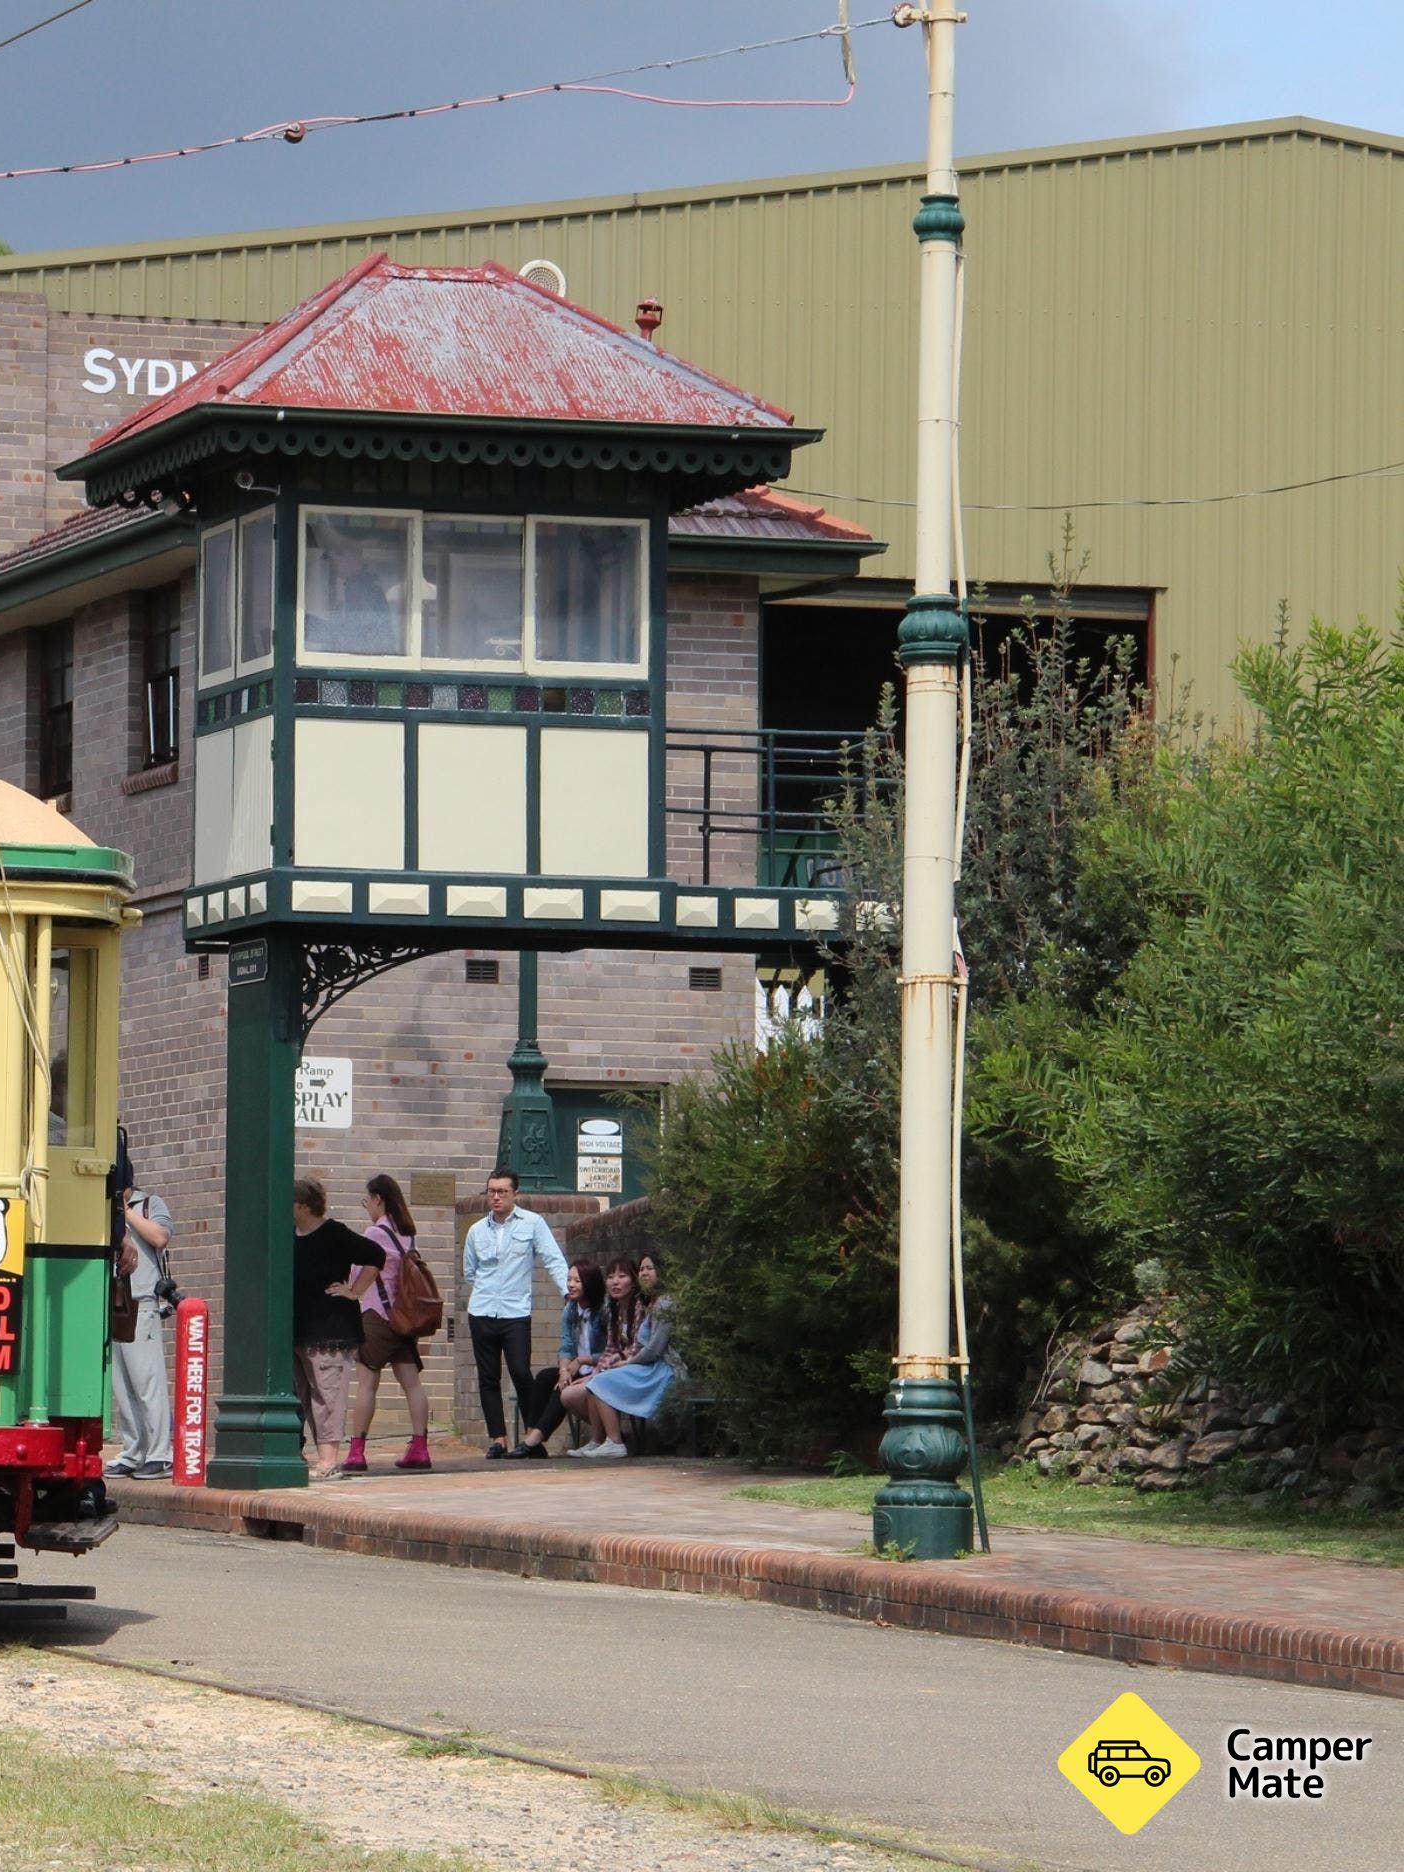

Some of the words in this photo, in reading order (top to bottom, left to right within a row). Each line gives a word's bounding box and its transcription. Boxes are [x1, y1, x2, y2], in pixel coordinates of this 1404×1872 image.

[300, 1061, 334, 1078] Ramp
[188, 1315, 204, 1353] WAIT
[187, 1357, 204, 1393] HERE
[186, 1396, 202, 1425] FOR
[185, 1428, 201, 1475] TRAM
